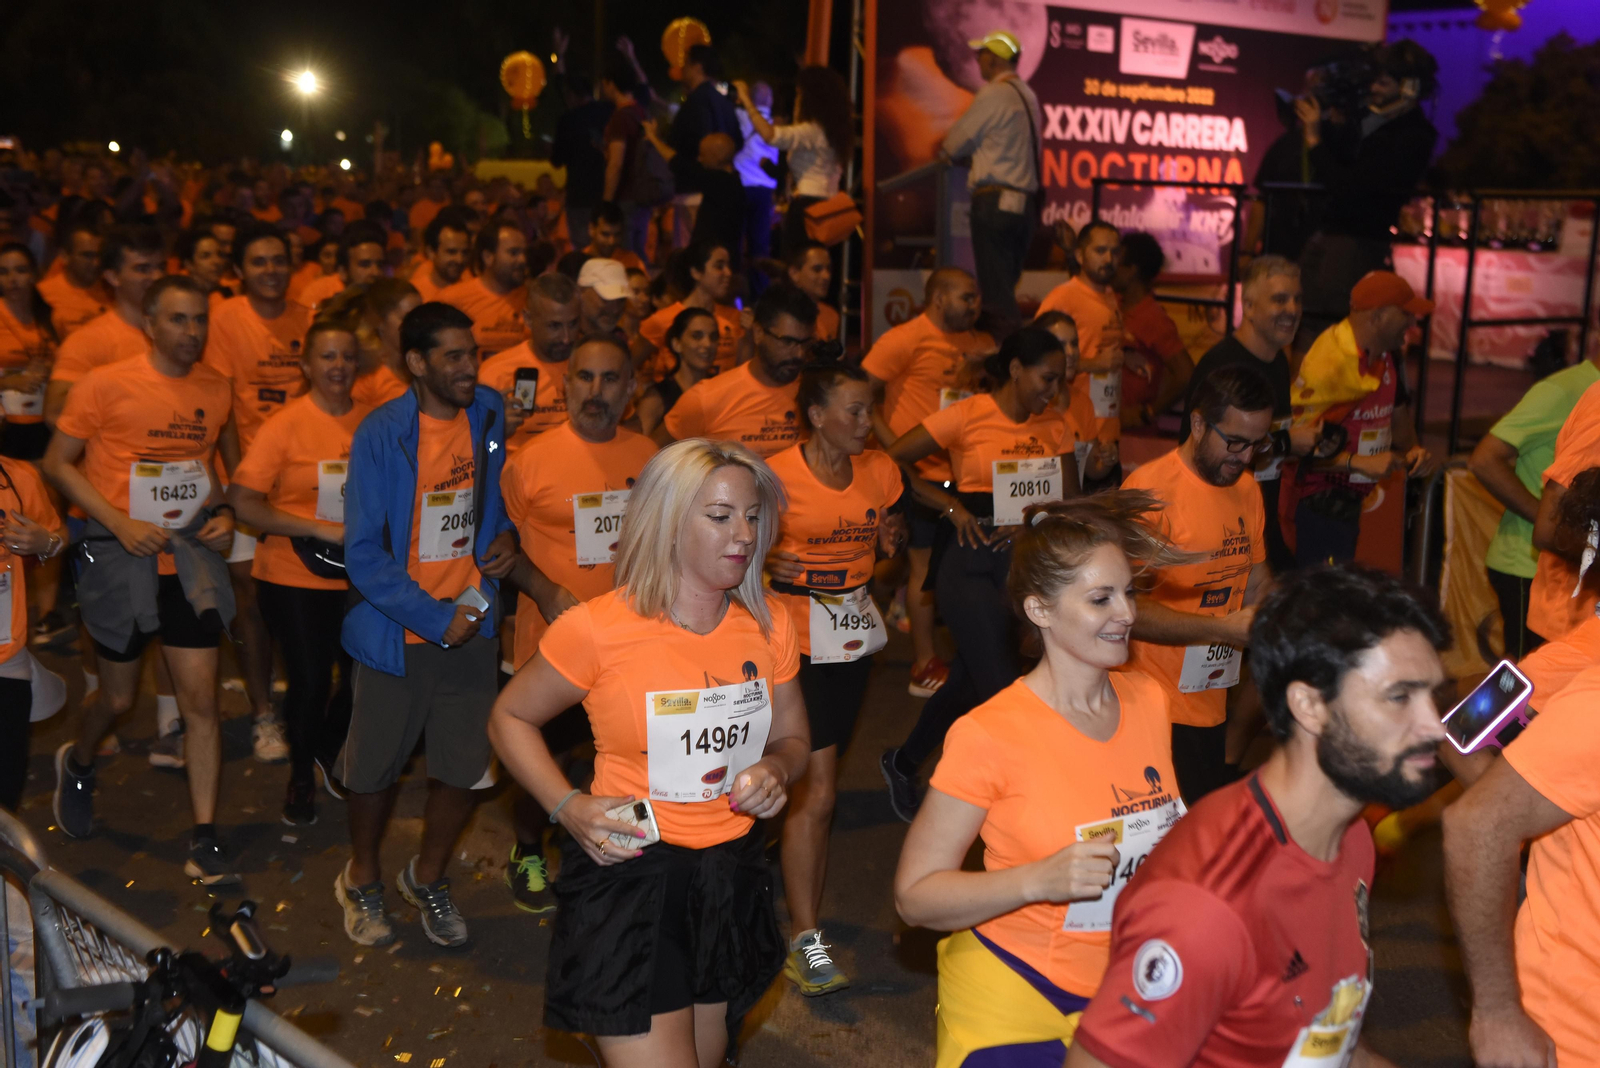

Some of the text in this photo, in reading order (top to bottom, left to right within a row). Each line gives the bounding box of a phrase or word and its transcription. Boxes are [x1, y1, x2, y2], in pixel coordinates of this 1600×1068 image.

[1084, 78, 1100, 96] 30
[1101, 80, 1117, 98] de
[1118, 82, 1186, 104] septiembre
[1043, 104, 1248, 153] XXXIV CARRERA
[1043, 149, 1244, 195] NOCTURNA
[147, 429, 185, 439] SEVILLA
[741, 434, 779, 442] SEVILLA
[434, 472, 470, 492] SEVILLA
[1010, 480, 1050, 498] 20810
[150, 483, 198, 501] 16423
[594, 515, 625, 534] 207
[807, 532, 875, 545] SEVILLA KM7
[811, 573, 840, 583] Sevilla
[830, 612, 876, 631] 14992
[661, 697, 691, 706] Sevilla
[732, 697, 753, 706] SEVILLA
[680, 721, 750, 755] 14961
[1111, 793, 1173, 818] NOCTURNA
